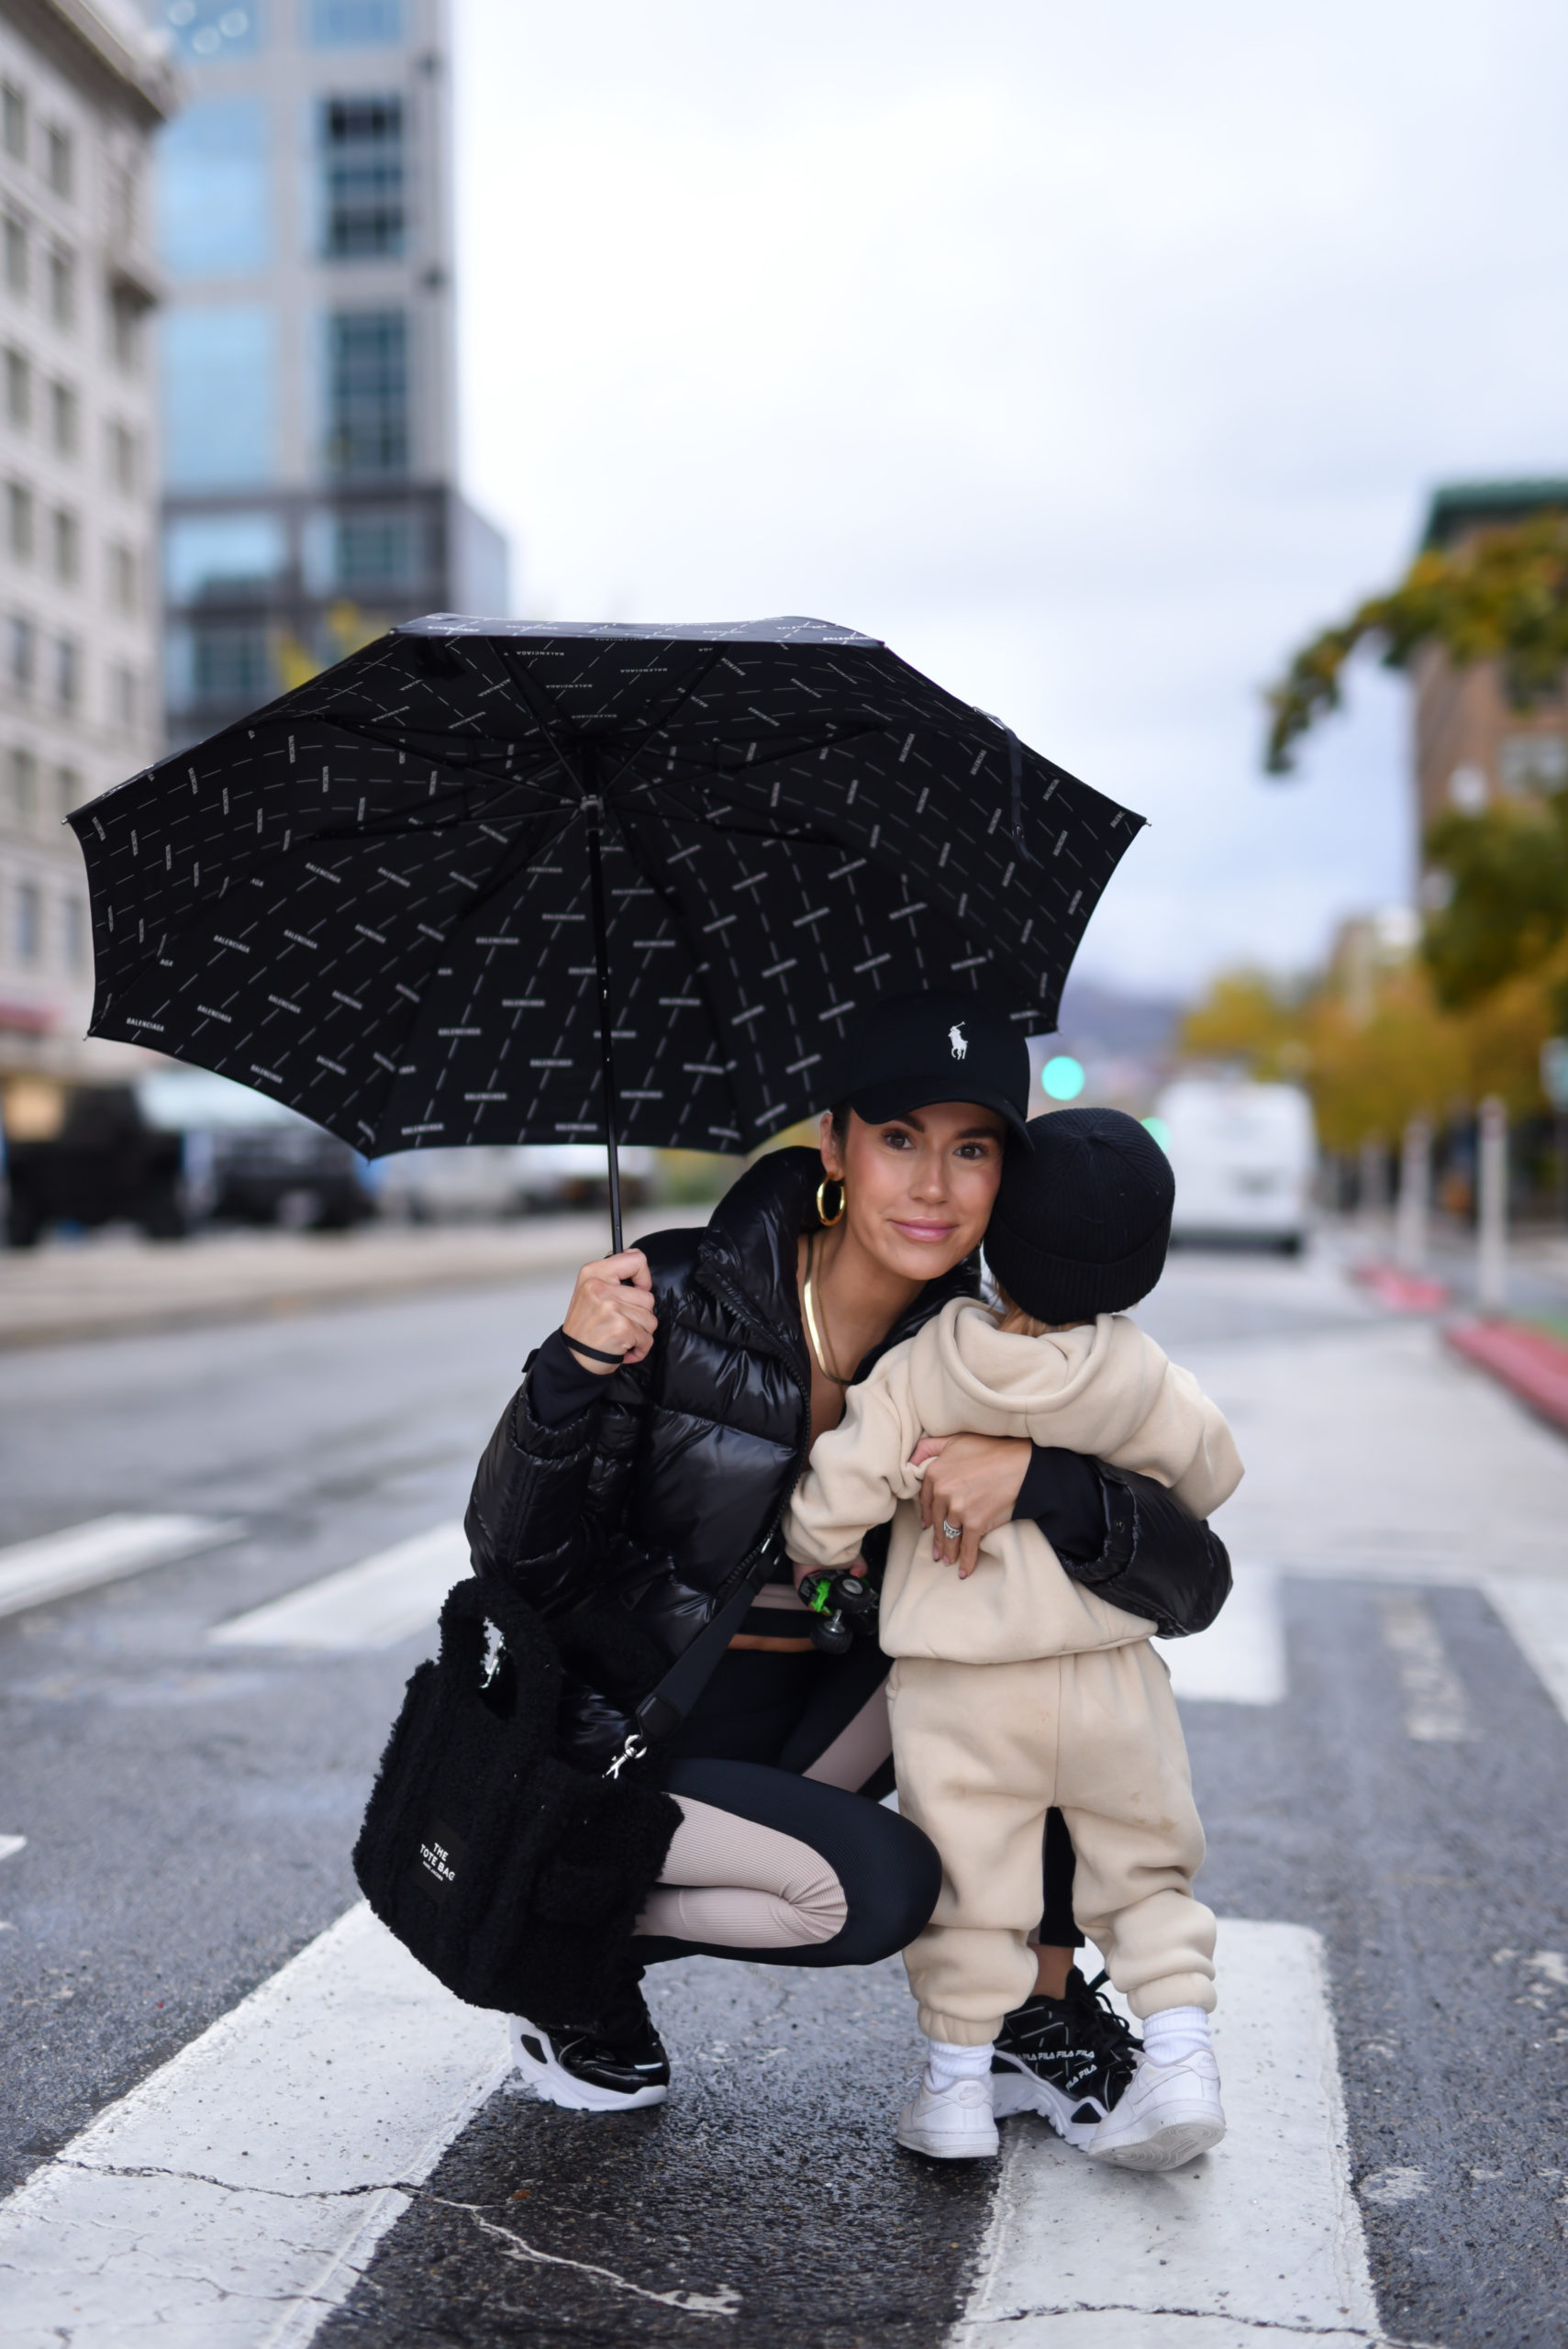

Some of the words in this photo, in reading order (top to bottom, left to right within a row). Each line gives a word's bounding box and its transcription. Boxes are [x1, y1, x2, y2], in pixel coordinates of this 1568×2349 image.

[305, 863, 341, 884] BALENCIAGA
[214, 935, 250, 953] BALENCIAGA
[126, 1018, 164, 1032] BALENCIAGA
[433, 1842, 449, 1862] THE
[420, 1843, 439, 1866] TOTE
[437, 1861, 456, 1881] BAG
[1038, 2052, 1055, 2060] FILA
[1056, 2050, 1074, 2059] FILA
[1075, 2049, 1095, 2059] FILA
[1078, 2064, 1097, 2079] FILA
